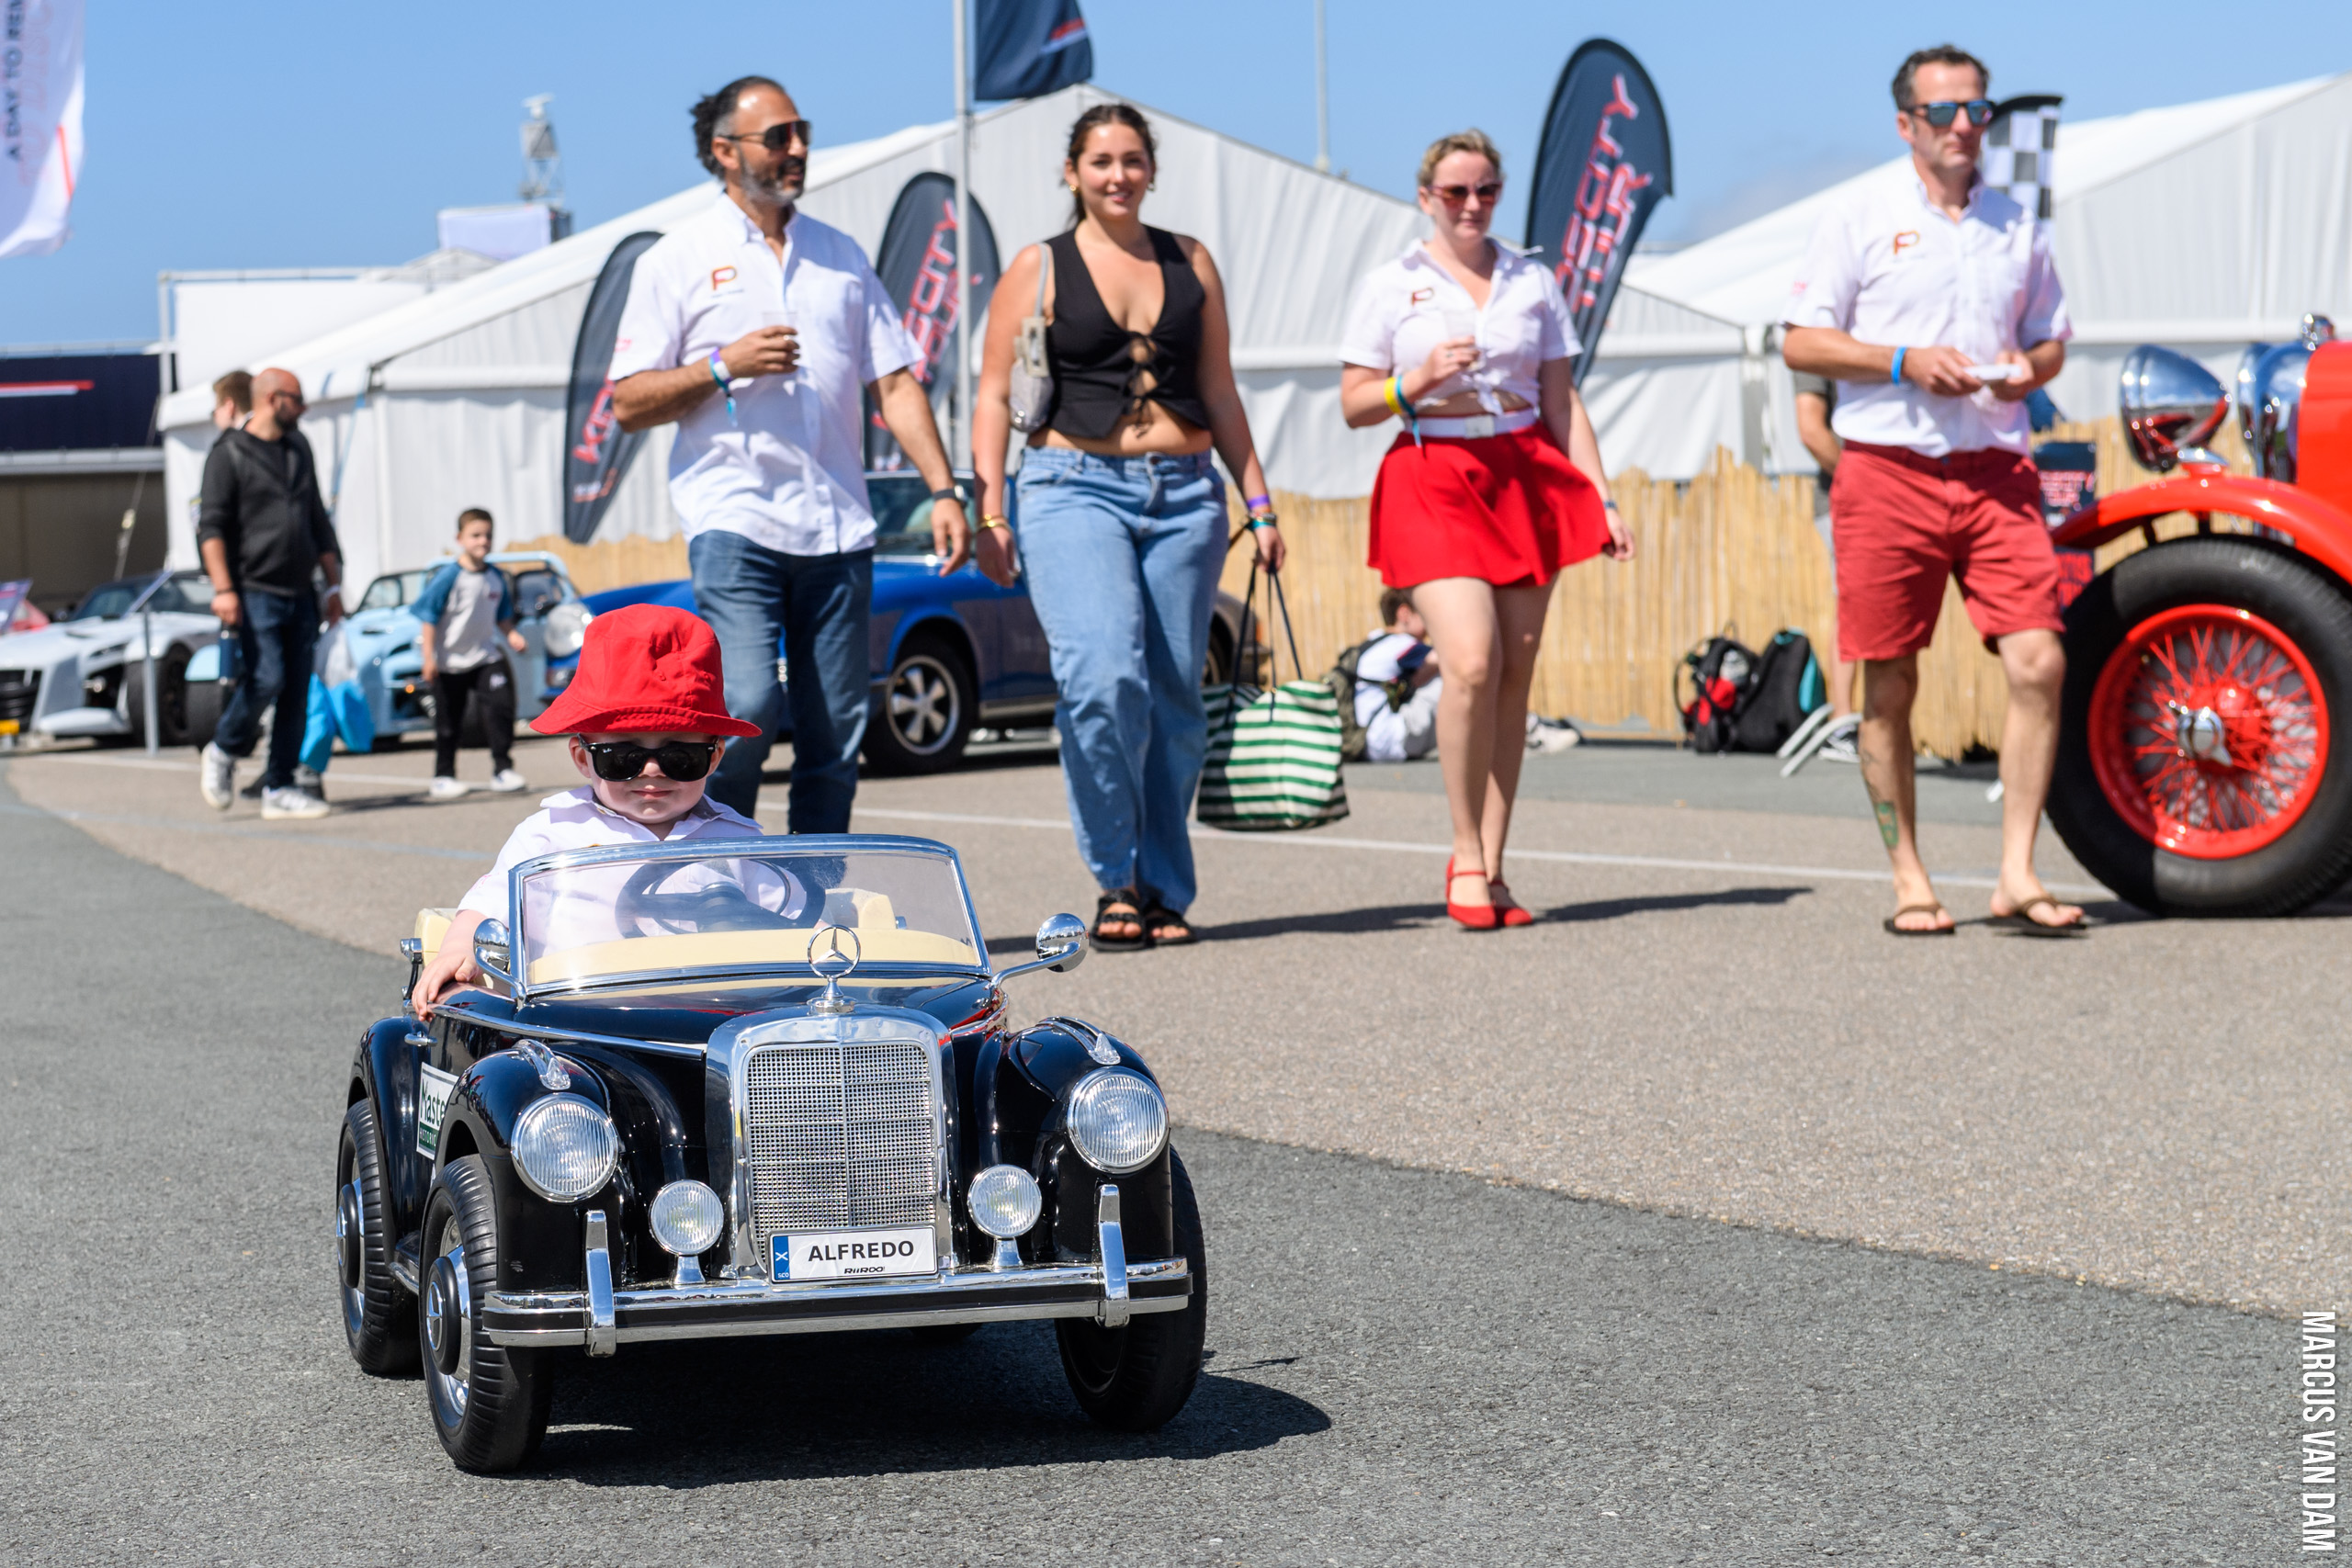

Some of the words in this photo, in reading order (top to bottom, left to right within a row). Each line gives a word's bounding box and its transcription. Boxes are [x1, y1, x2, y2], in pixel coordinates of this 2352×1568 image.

[5, 48, 23, 79] TO
[6, 88, 22, 137] DAY
[808, 1240, 915, 1263] ALFREDO
